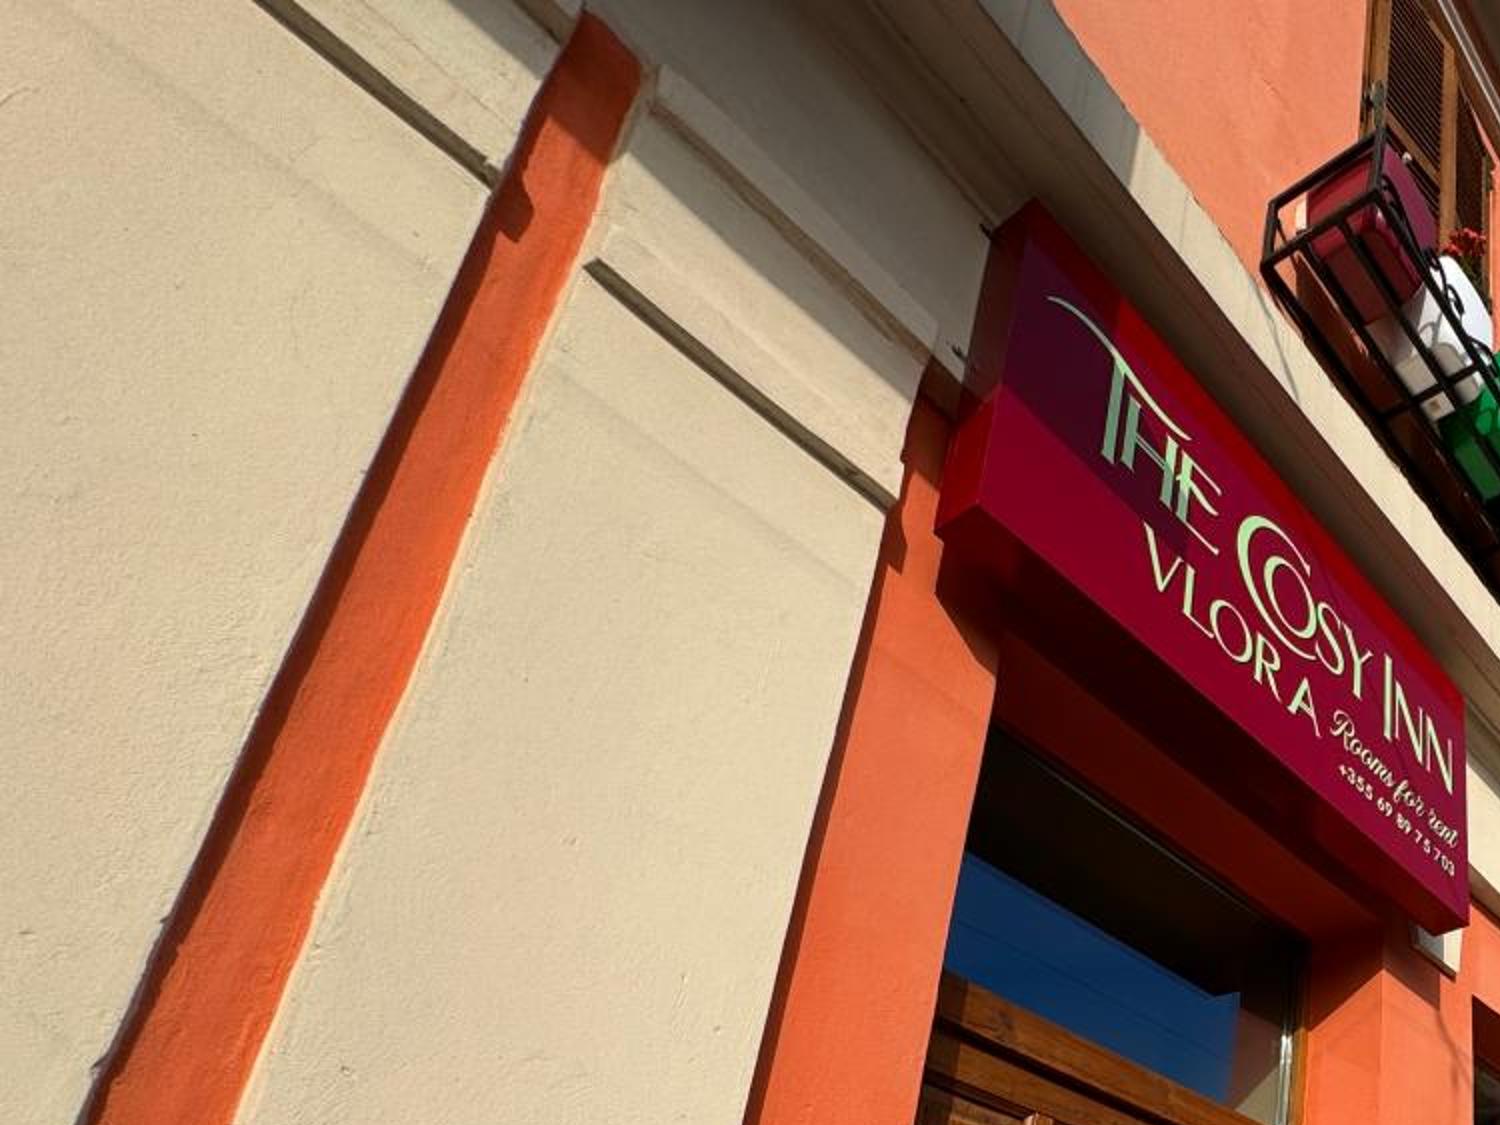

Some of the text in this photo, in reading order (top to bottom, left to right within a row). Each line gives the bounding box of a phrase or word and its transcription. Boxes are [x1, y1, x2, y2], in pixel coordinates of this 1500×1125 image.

[1048, 296, 1453, 795] THE COSY INN
[1144, 521, 1320, 738] VLORA
[1331, 710, 1458, 849] Rooms for rent
[1339, 764, 1374, 800] +355
